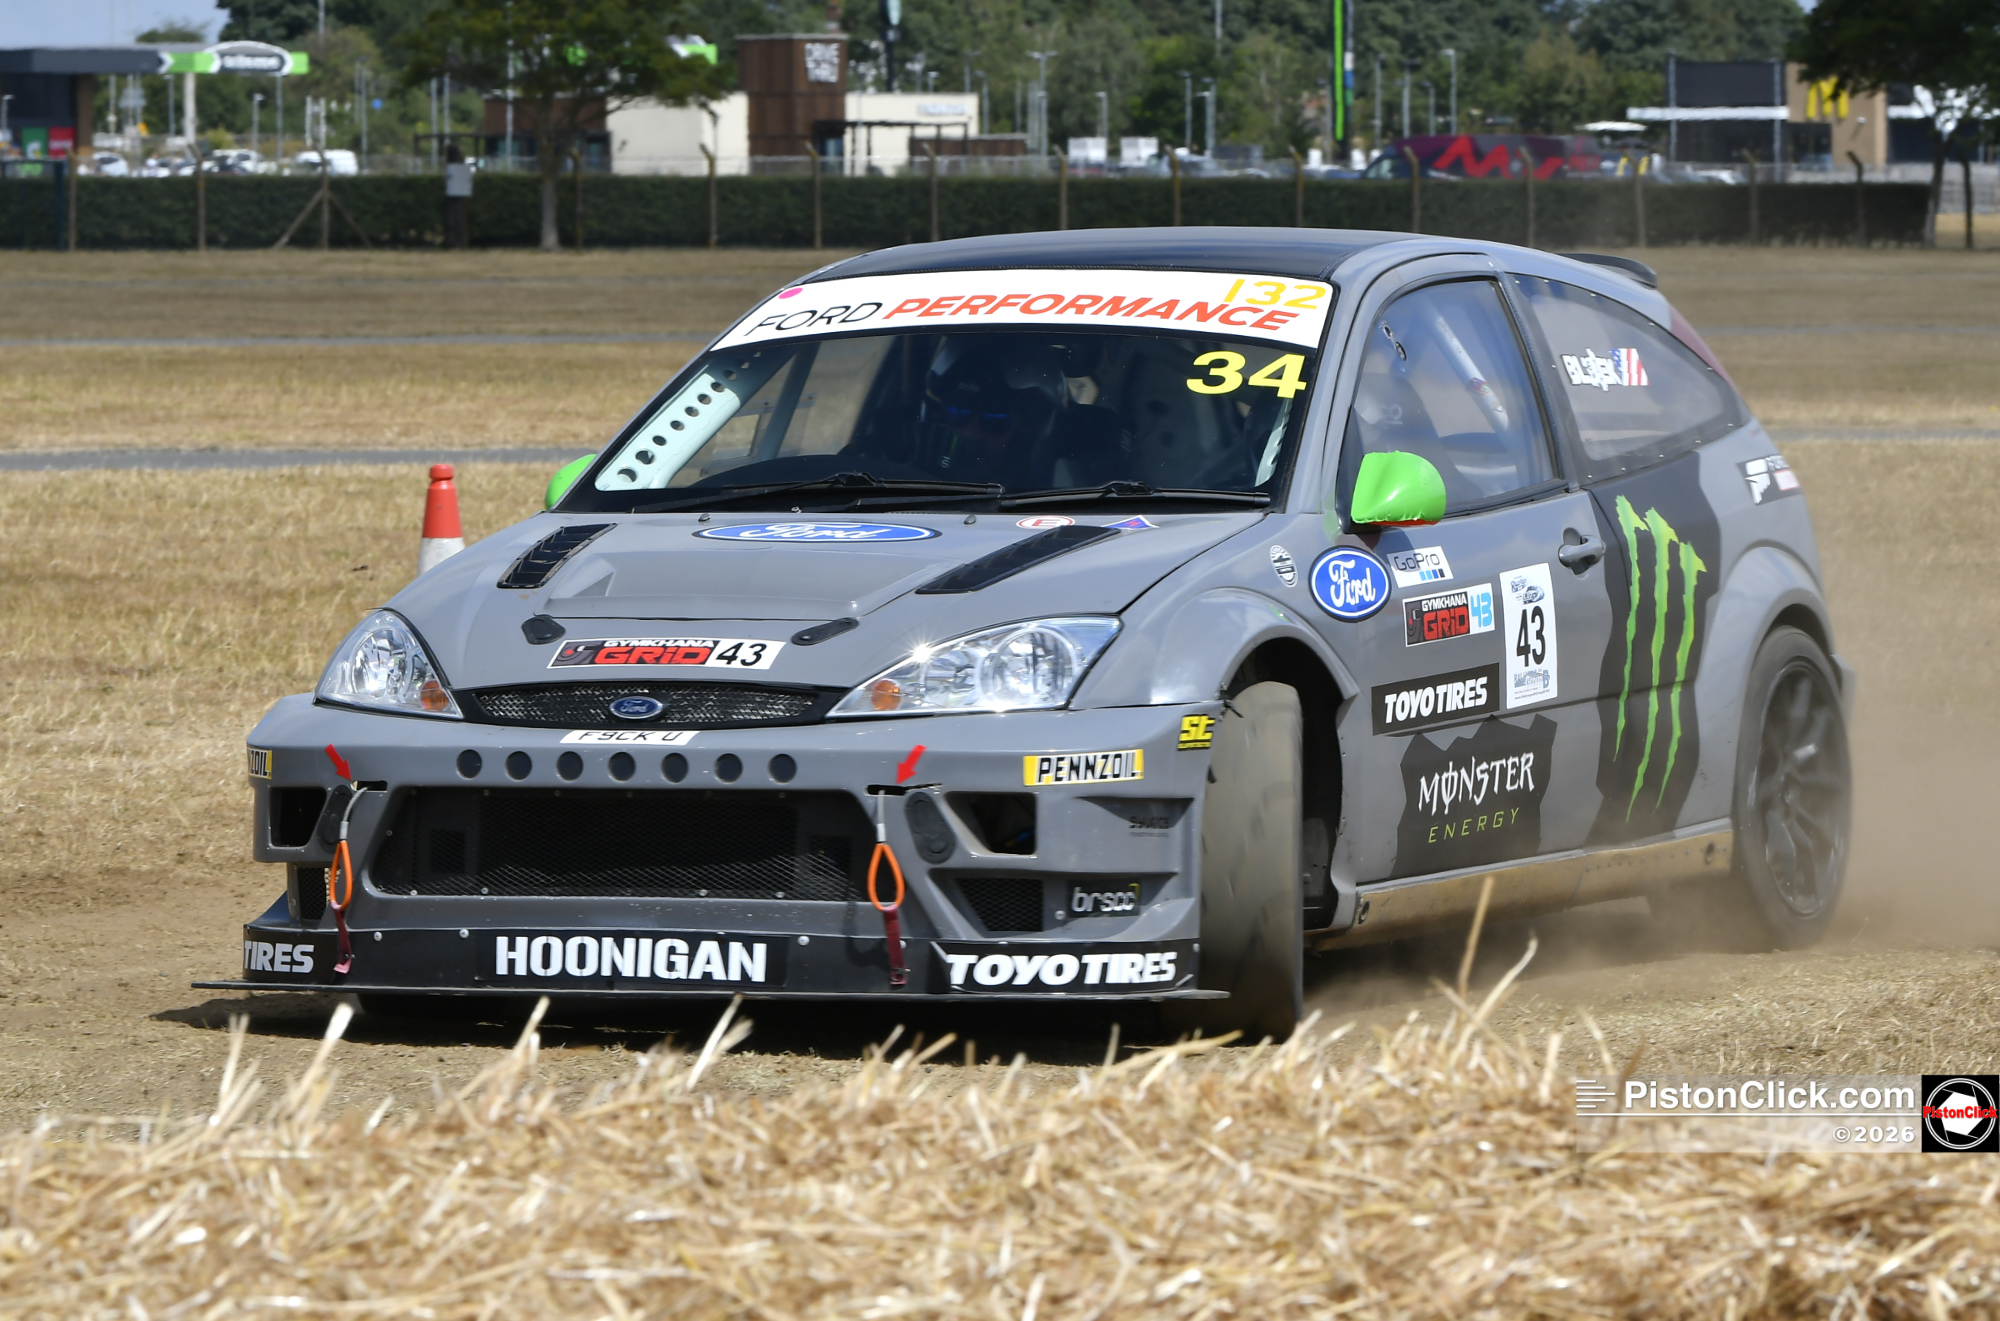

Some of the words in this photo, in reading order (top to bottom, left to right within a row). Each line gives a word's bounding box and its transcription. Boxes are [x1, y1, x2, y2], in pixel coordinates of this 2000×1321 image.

[1223, 279, 1326, 309] 132
[743, 302, 883, 336] FORD
[882, 294, 1300, 331] PERFORMANCE
[1186, 351, 1307, 398] 34
[738, 522, 891, 540] Ford
[1394, 552, 1440, 571] GoPro
[1329, 558, 1376, 608] Ford
[1421, 591, 1468, 612] GYMKHANA
[1470, 591, 1493, 628] 43
[603, 638, 717, 648] GYMKHANA
[1516, 605, 1547, 668] 43
[716, 642, 768, 667] 43
[620, 699, 650, 713] Ford
[1384, 686, 1434, 724] TOYO
[1435, 676, 1489, 714] TIRES
[661, 731, 684, 742] U
[1037, 752, 1140, 783] PENNZOIL
[1428, 807, 1520, 843] ENERGY
[1071, 886, 1136, 912] brscc
[495, 935, 768, 983] HOONIGAN
[946, 953, 1080, 986] TOYO
[1080, 951, 1178, 985] TIRES
